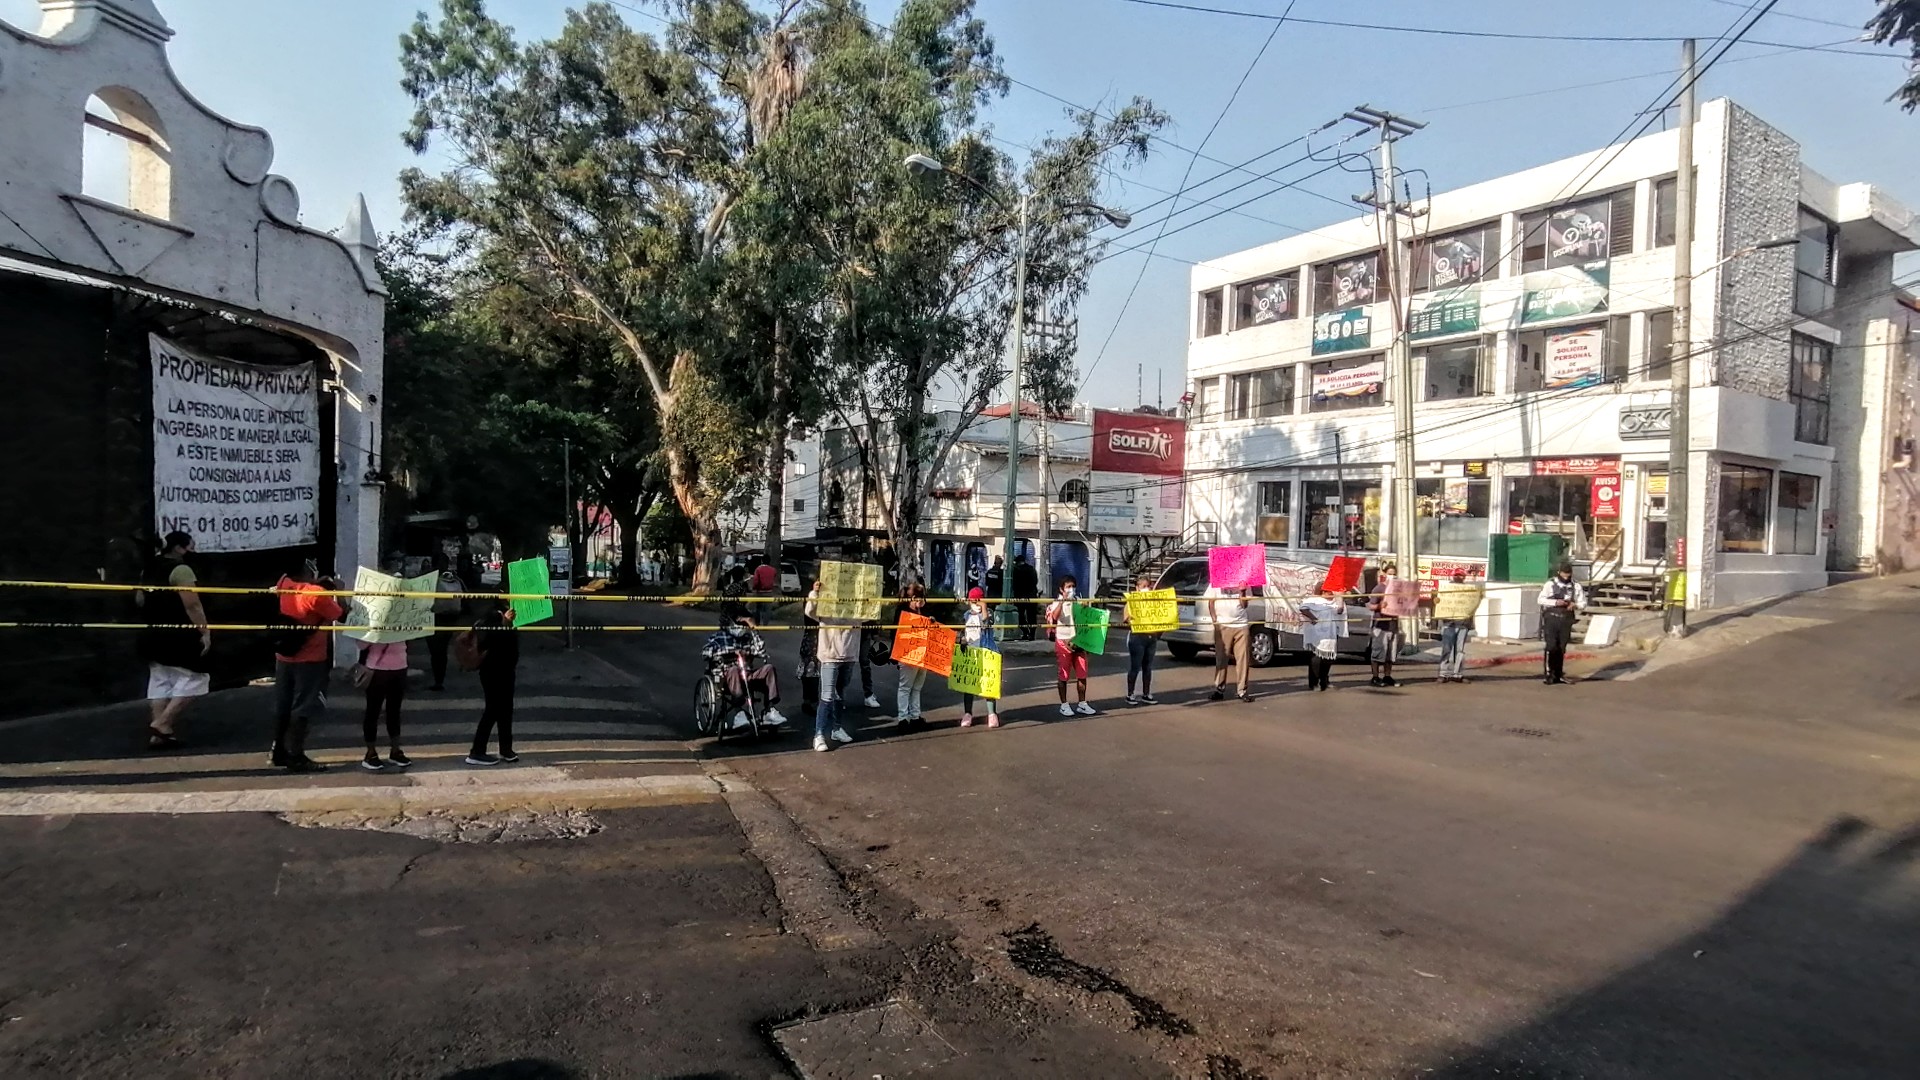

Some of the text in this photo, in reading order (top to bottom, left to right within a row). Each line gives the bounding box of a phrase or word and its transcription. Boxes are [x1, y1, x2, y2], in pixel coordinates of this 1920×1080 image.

[1553, 353, 1592, 361] PERSONAL
[160, 353, 311, 395] PROPIEDAD PRIVADA
[1353, 370, 1379, 379] PERSONAL
[169, 398, 185, 415] LA
[187, 401, 240, 422] PERSONA
[243, 408, 265, 424] QUE
[157, 418, 314, 444] INGRESAR DE MANERA ILEGAL
[177, 443, 301, 464] A ESTE INMUEBLE SERA
[189, 466, 292, 484] CONSIGNADA A LAS
[1595, 477, 1618, 485] AVISO
[160, 486, 313, 504] AUTORIDADES COMPETENTES
[198, 517, 216, 532] 01
[222, 517, 249, 533] 800
[255, 514, 279, 531] 540
[282, 513, 299, 529] 54
[1135, 609, 1168, 618] CLARAS
